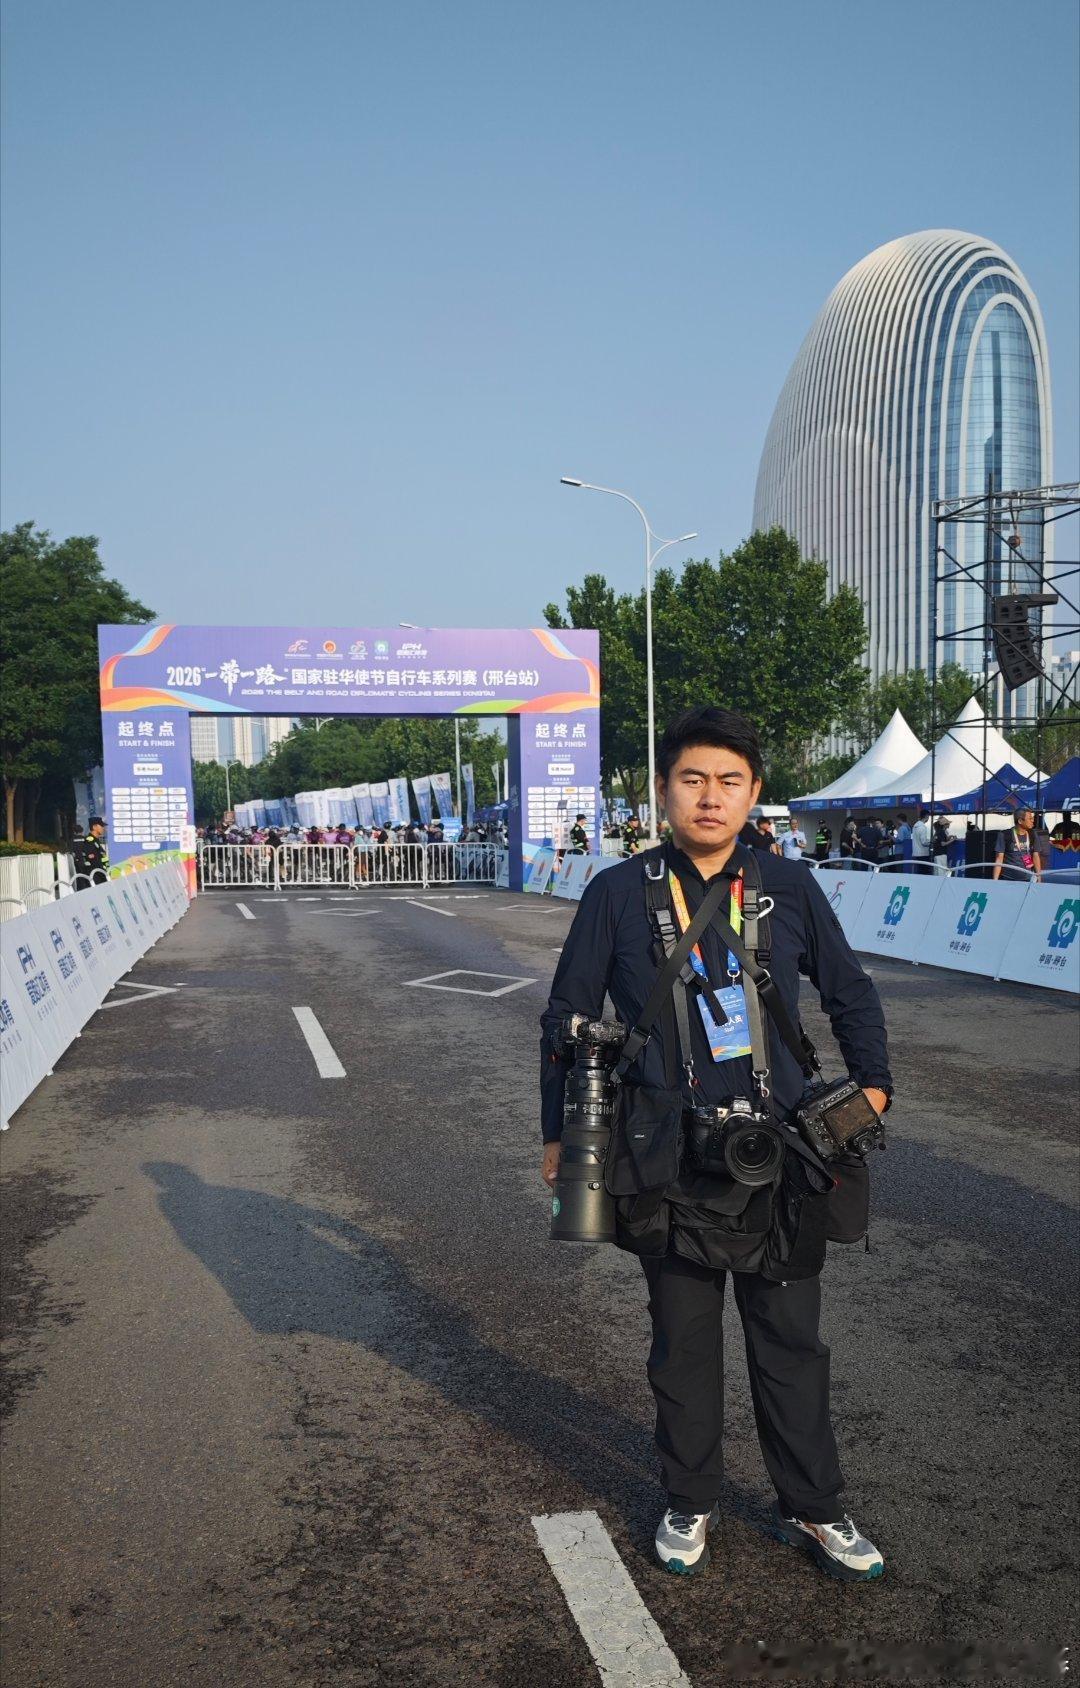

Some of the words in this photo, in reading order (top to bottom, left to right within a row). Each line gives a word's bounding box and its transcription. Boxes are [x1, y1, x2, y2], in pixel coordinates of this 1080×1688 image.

[118, 721, 174, 736] 起终点
[535, 723, 586, 738] 起终点
